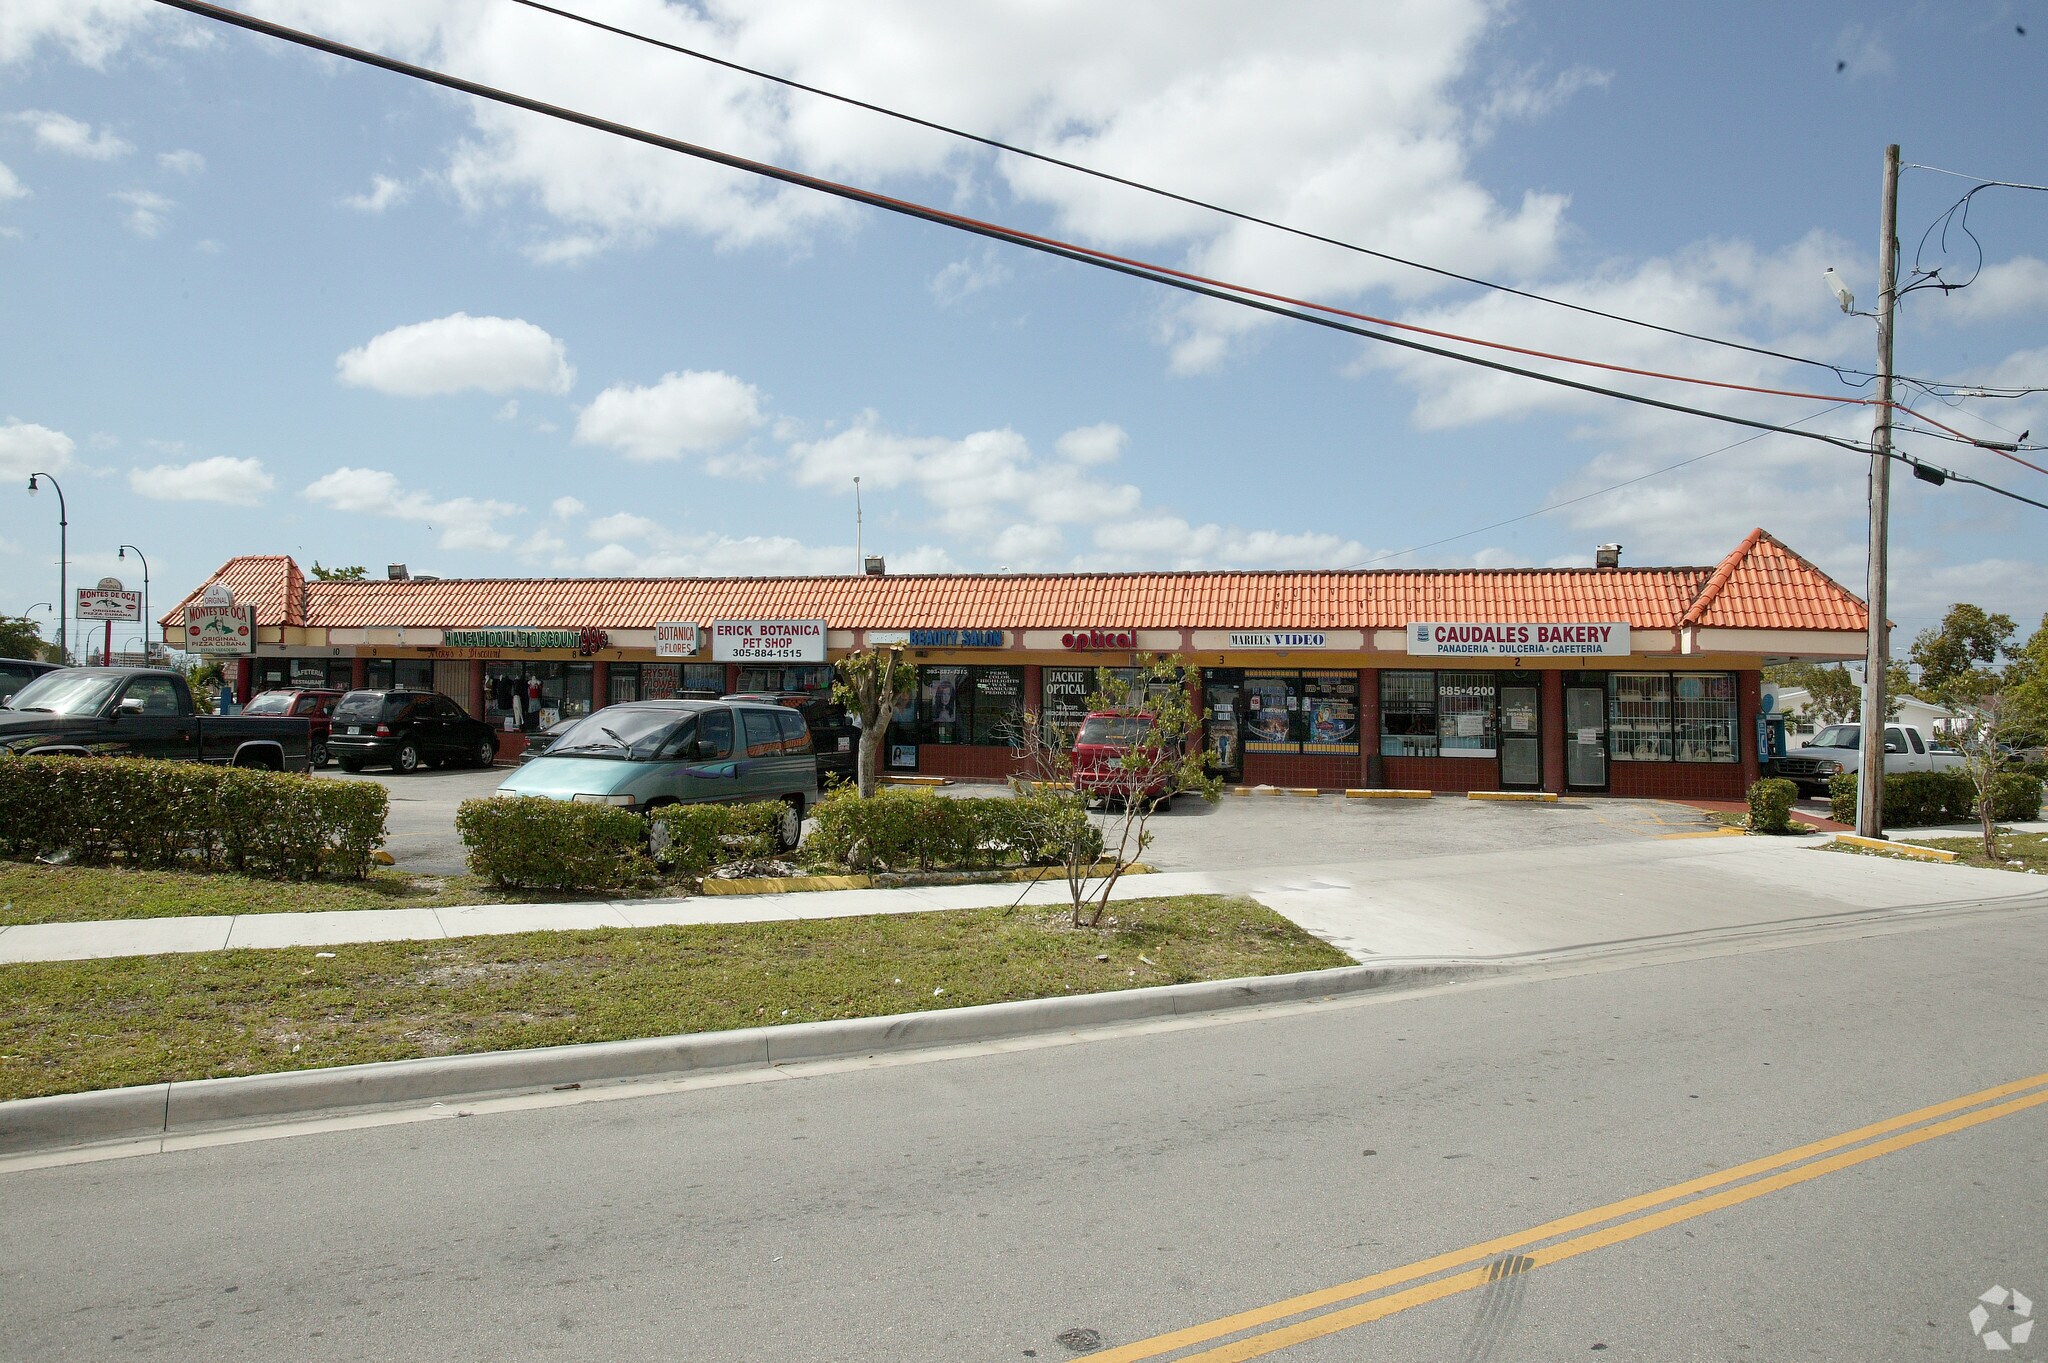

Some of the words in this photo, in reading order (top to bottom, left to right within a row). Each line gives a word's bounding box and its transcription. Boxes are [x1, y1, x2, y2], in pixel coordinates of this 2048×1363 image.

[80, 591, 108, 599] MONTES
[121, 593, 135, 602] OCA
[189, 607, 218, 623] MONTES
[220, 608, 229, 616] DE
[231, 607, 247, 622] OCA
[659, 627, 694, 640] BOTANICA
[717, 625, 752, 635] ERICK
[760, 625, 820, 636] BOTANICA
[1435, 626, 1529, 643] CAUDALES
[1538, 627, 1612, 643] BAKERY
[530, 631, 580, 648] DISCOUNT
[743, 638, 761, 648] PET
[765, 638, 792, 648] SHOP
[910, 630, 959, 646] BEAUTY
[961, 630, 1004, 646] SALON
[1062, 629, 1137, 653] optical
[1232, 635, 1271, 645] MARIEL'S
[1274, 635, 1324, 646] VIDEO
[665, 644, 691, 653] FLORES
[733, 649, 802, 658] 305-884-1515
[1438, 645, 1488, 653] PANADERIA
[1500, 645, 1544, 653] DULCERIA
[1552, 645, 1602, 653] CAFETERIA
[617, 651, 622, 659] 7
[1219, 655, 1224, 664] 3
[1515, 658, 1520, 666] 2
[641, 668, 678, 677] CRYSTAL
[1050, 672, 1084, 682] JACKIE
[642, 681, 678, 689] FLOWER
[1046, 684, 1087, 695] OPTICAL
